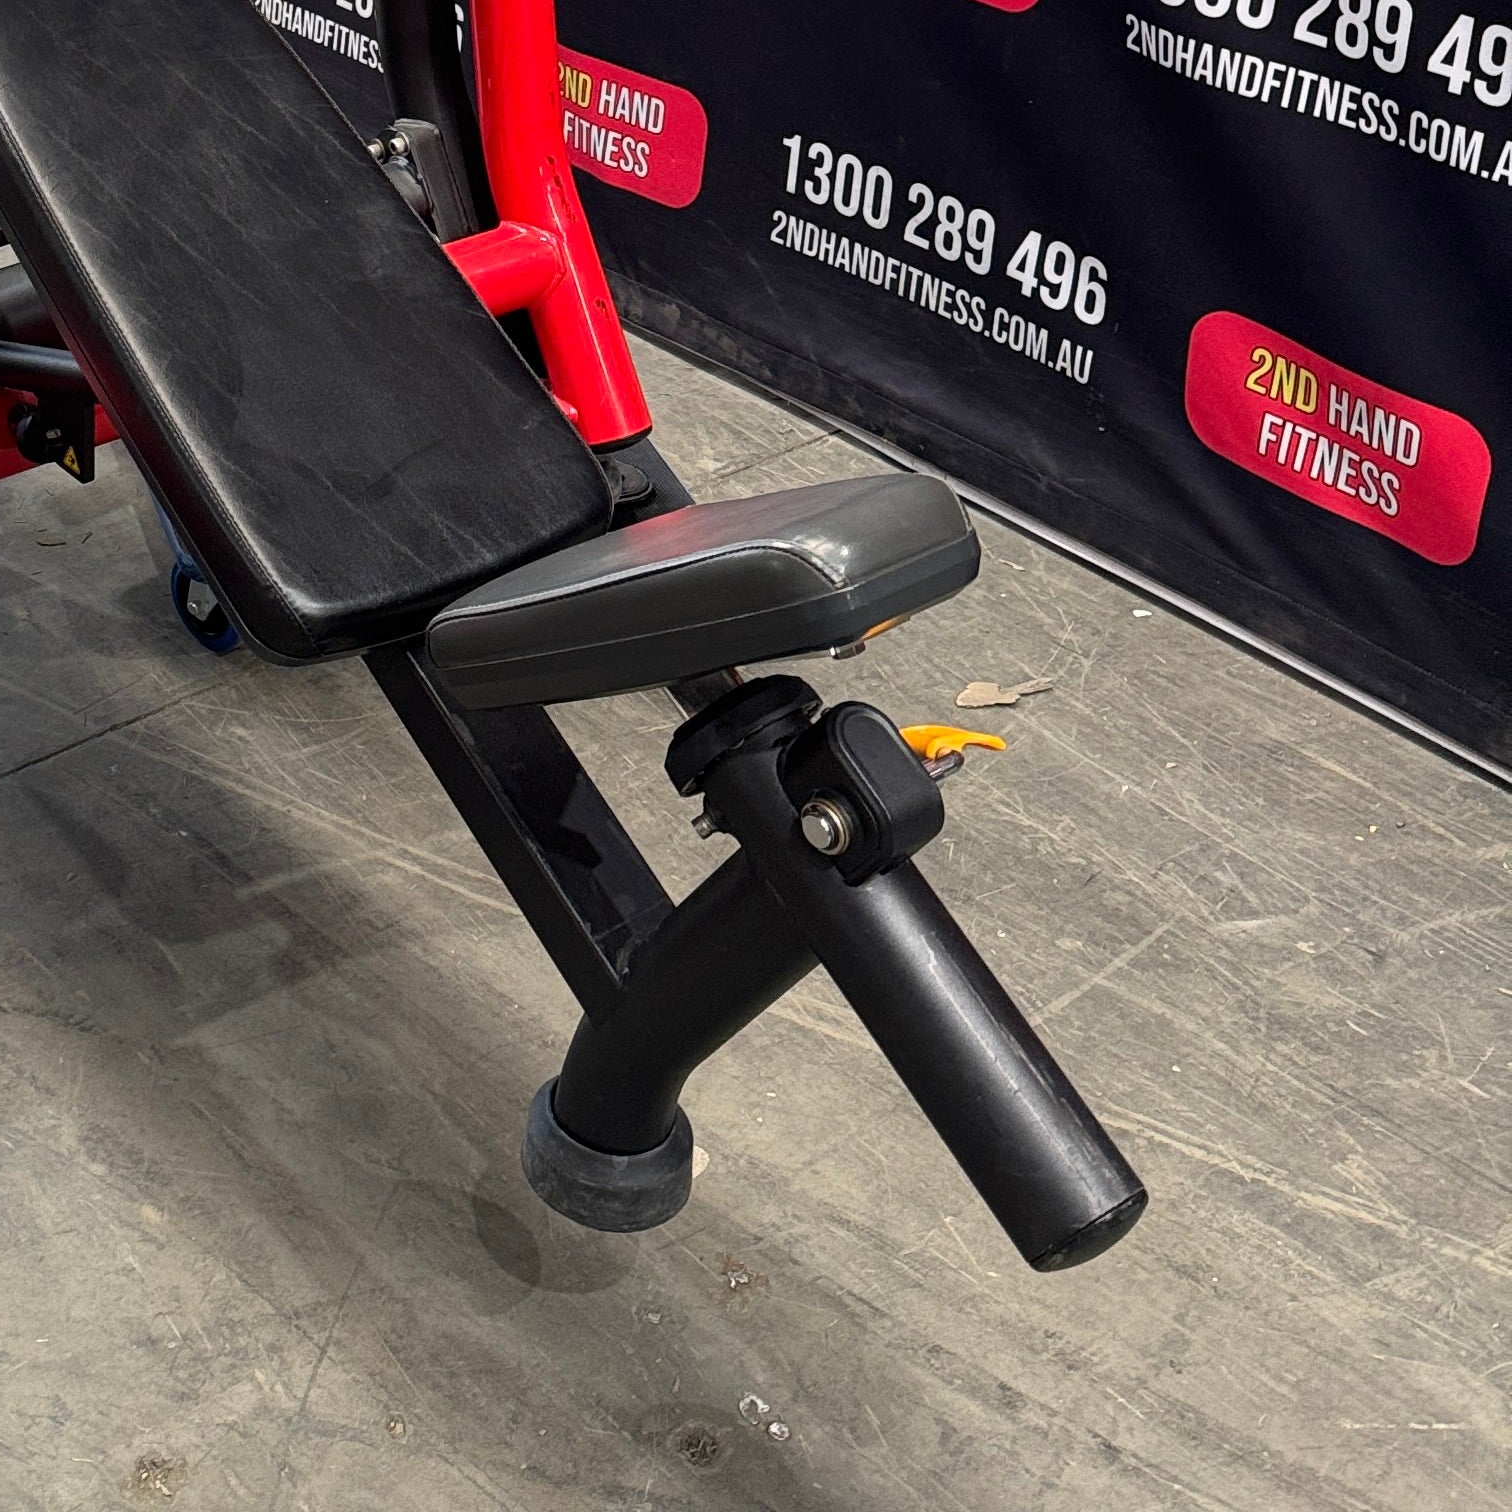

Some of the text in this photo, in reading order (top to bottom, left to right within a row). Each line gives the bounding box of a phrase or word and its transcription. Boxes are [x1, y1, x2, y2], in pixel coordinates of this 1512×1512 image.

[563, 110, 650, 178] FITNESS
[599, 80, 664, 133] HAND
[783, 135, 1107, 325] 1300 289 496
[771, 209, 1093, 384] 2NDHANDFITNESS.COM.AU
[1247, 349, 1420, 465] 2ND HAND
[1259, 413, 1399, 515] FITNESS
